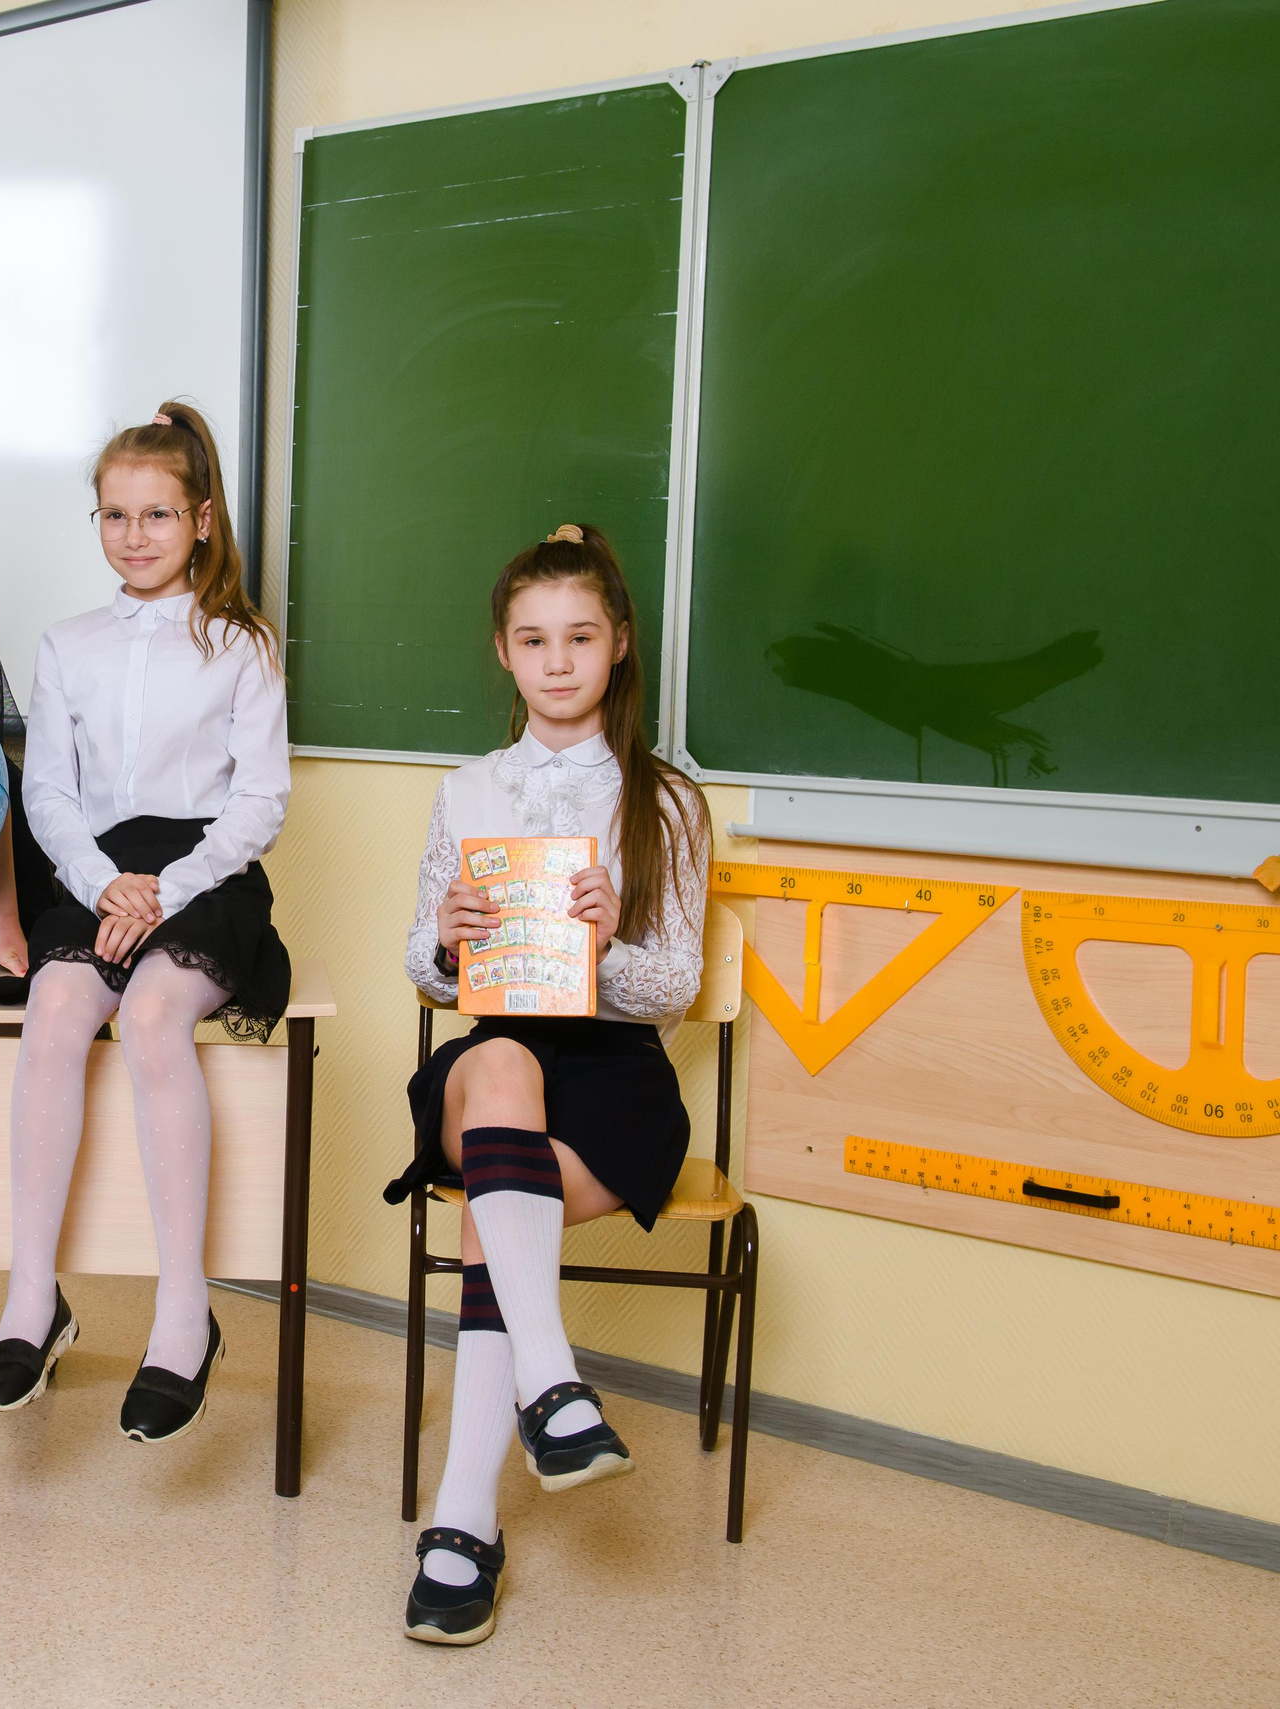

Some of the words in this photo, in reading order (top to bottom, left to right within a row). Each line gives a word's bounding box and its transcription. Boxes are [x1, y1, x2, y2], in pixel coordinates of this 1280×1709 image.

[718, 872, 731, 882] 10
[781, 877, 795, 888] 20
[847, 883, 862, 895] 30
[915, 889, 932, 901] 40
[978, 895, 995, 907] 50
[1024, 901, 1029, 909] 0
[1094, 907, 1104, 915] 10
[1173, 913, 1185, 922] 20
[1257, 919, 1269, 928] 30
[1034, 906, 1042, 923] 180
[1035, 937, 1043, 955] 170
[1046, 941, 1053, 951] 10
[1040, 969, 1051, 986] 160
[1051, 968, 1060, 980] 20
[1051, 999, 1064, 1016] 150
[1062, 997, 1073, 1009] 30
[1067, 1026, 1081, 1043] 140
[1078, 1023, 1089, 1035] 40
[1098, 1046, 1110, 1058] 50
[1088, 1051, 1103, 1067] 130
[1120, 1066, 1133, 1077] 60
[1112, 1073, 1128, 1088] 120
[1147, 1082, 1159, 1093] 70
[1140, 1090, 1157, 1104] 110
[1176, 1094, 1189, 1104] 80
[1171, 1103, 1188, 1115] 100
[1235, 1103, 1254, 1111] 100
[1267, 1099, 1280, 1109] 10
[1204, 1104, 1224, 1118] 90
[1240, 1114, 1253, 1123] 80
